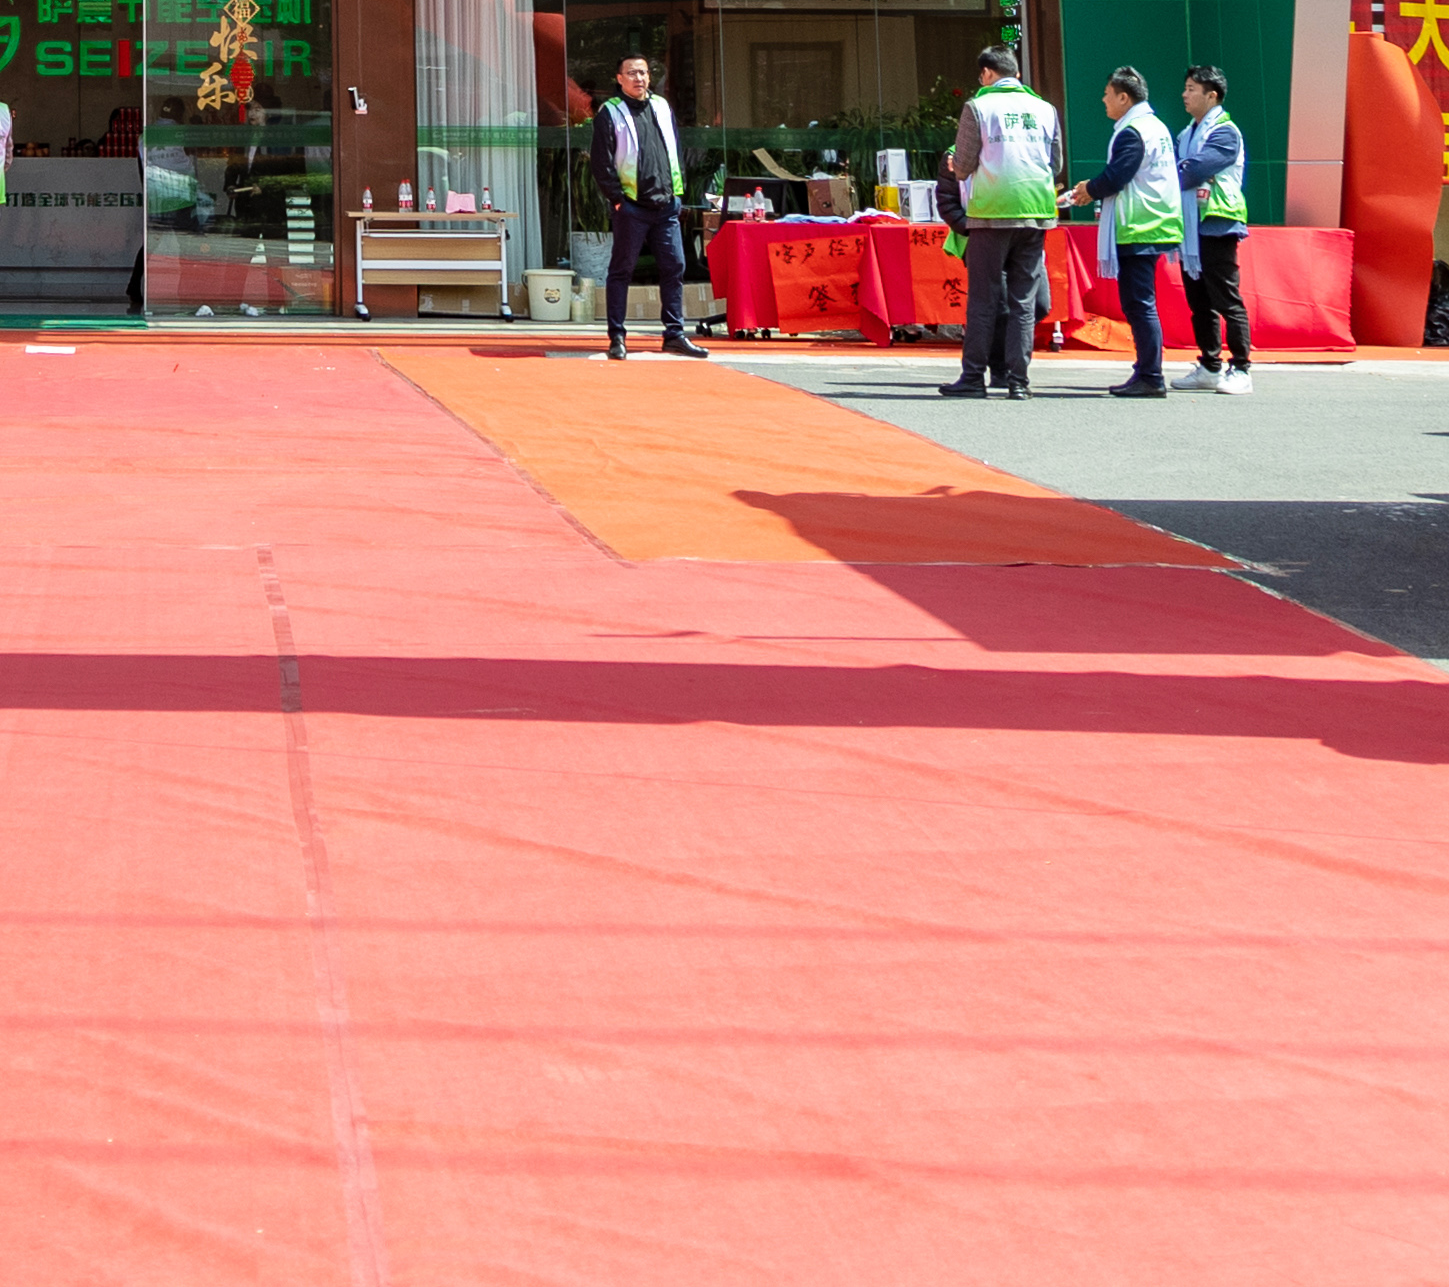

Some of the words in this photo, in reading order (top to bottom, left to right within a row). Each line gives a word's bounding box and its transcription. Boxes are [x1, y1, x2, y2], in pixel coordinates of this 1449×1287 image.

[35, 40, 208, 77] SEIZE
[226, 40, 311, 77] IR
[1004, 113, 1038, 130] 萨震
